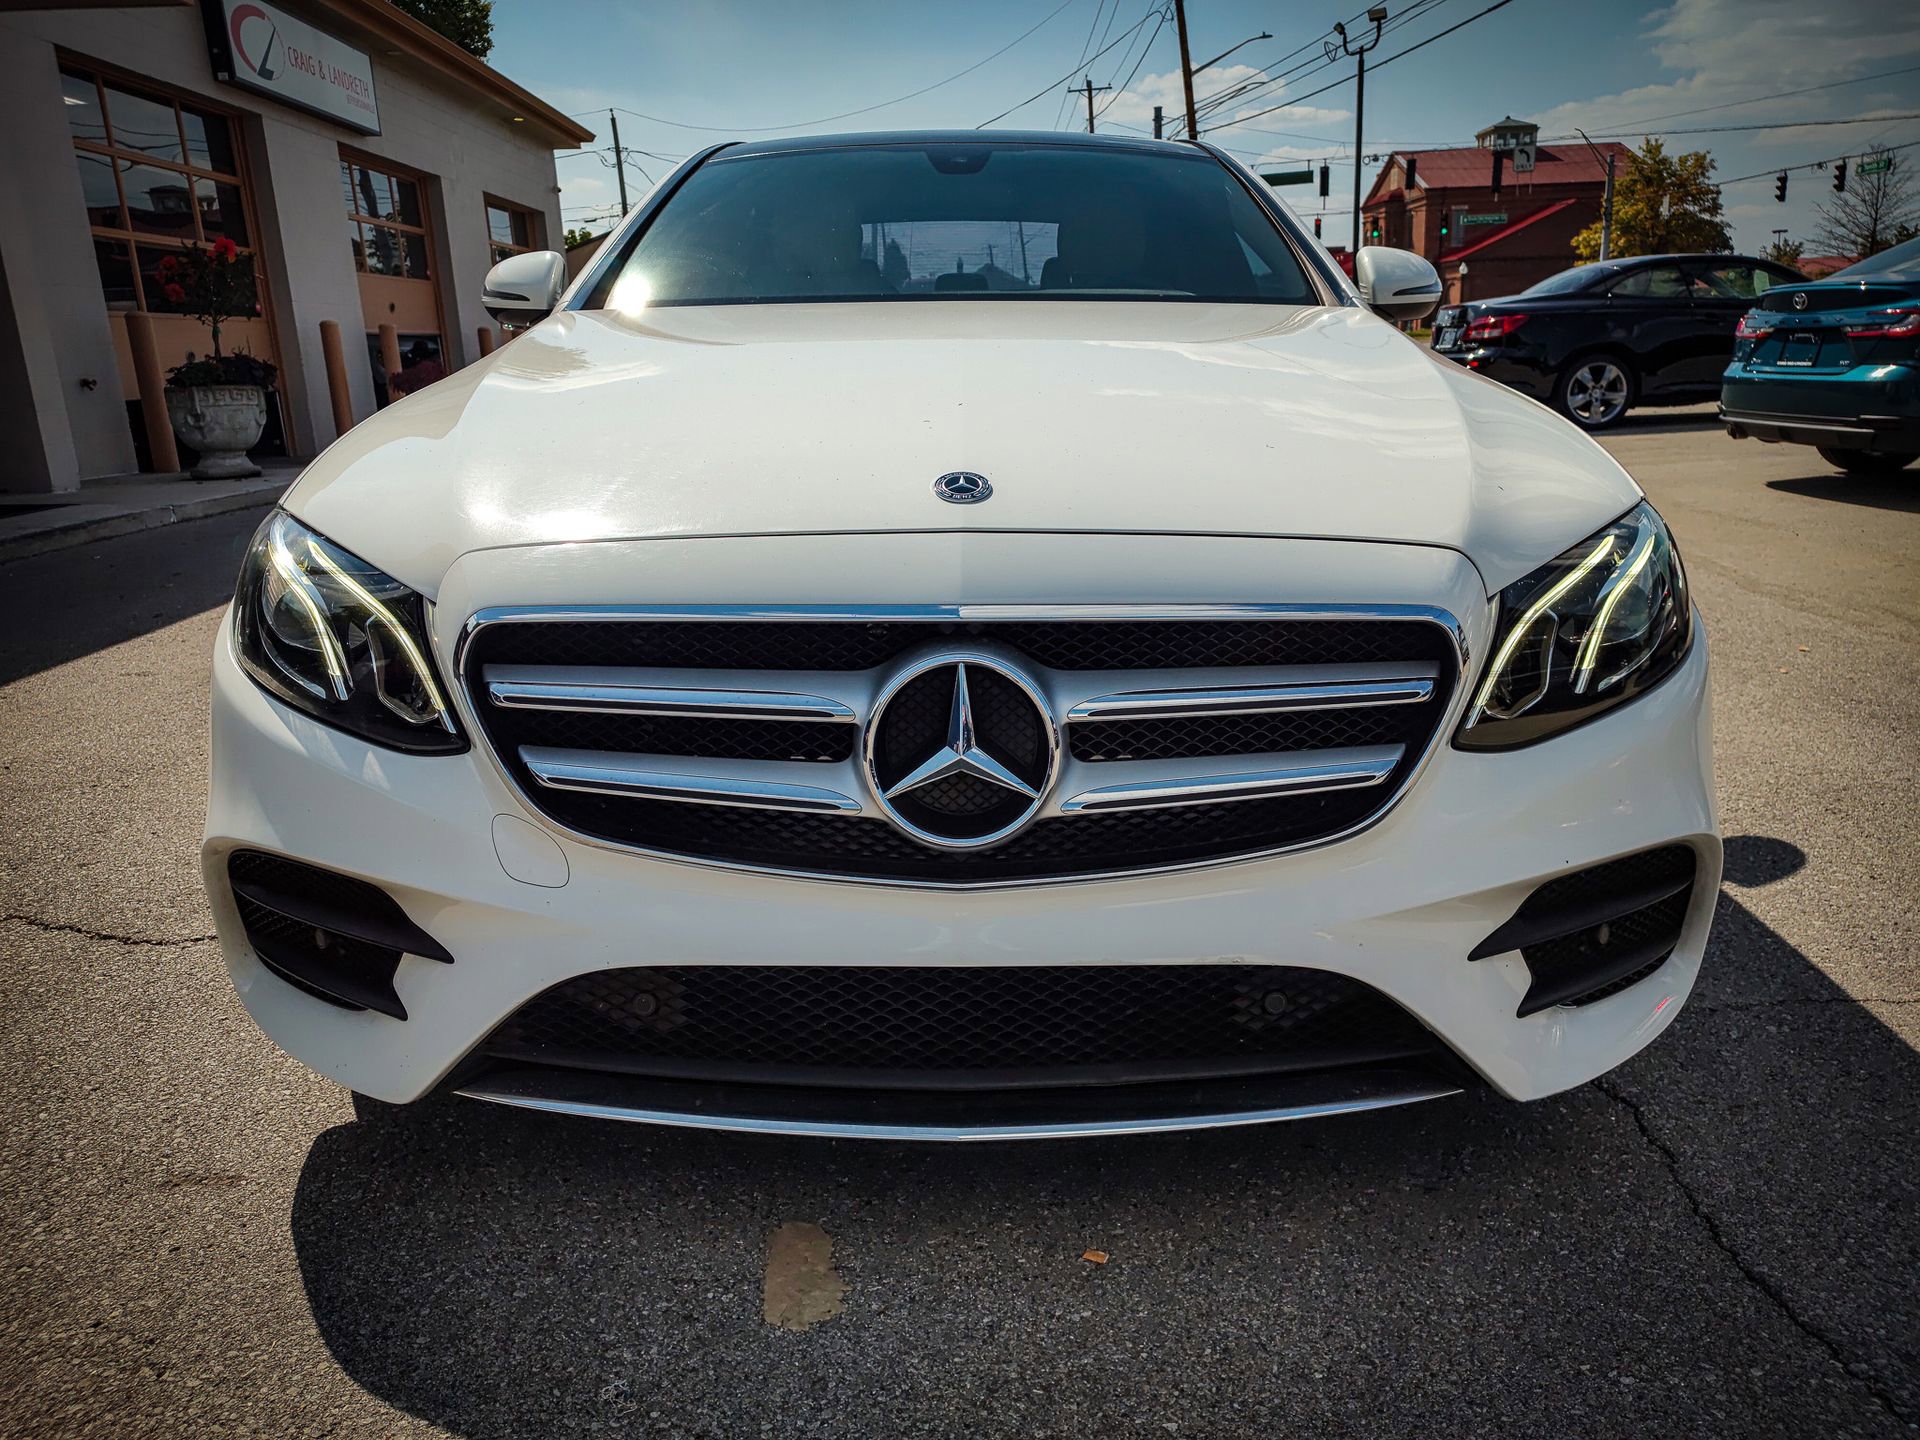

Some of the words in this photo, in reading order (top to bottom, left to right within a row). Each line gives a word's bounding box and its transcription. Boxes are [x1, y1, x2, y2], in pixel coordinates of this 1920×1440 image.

[287, 46, 316, 76] CRAIG
[318, 60, 326, 81] &
[327, 64, 370, 99] LANDRETH
